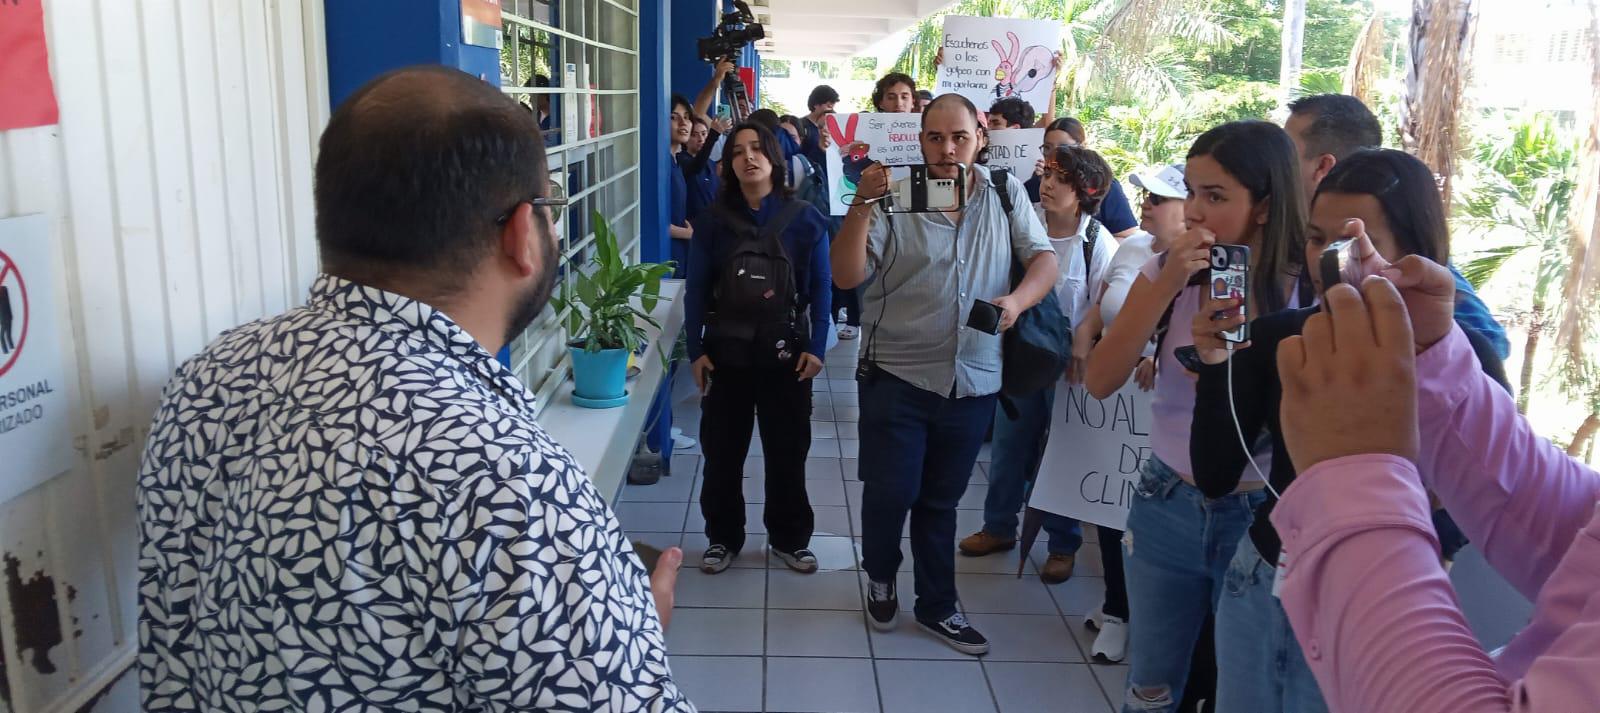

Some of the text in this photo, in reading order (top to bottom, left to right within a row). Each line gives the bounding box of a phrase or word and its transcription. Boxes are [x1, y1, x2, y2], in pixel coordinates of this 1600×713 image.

[965, 51, 978, 62] los
[868, 119, 886, 130] Ser
[987, 144, 1029, 160] RTAD DE
[1065, 386, 1150, 437] NO AL
[1118, 443, 1153, 475] DE
